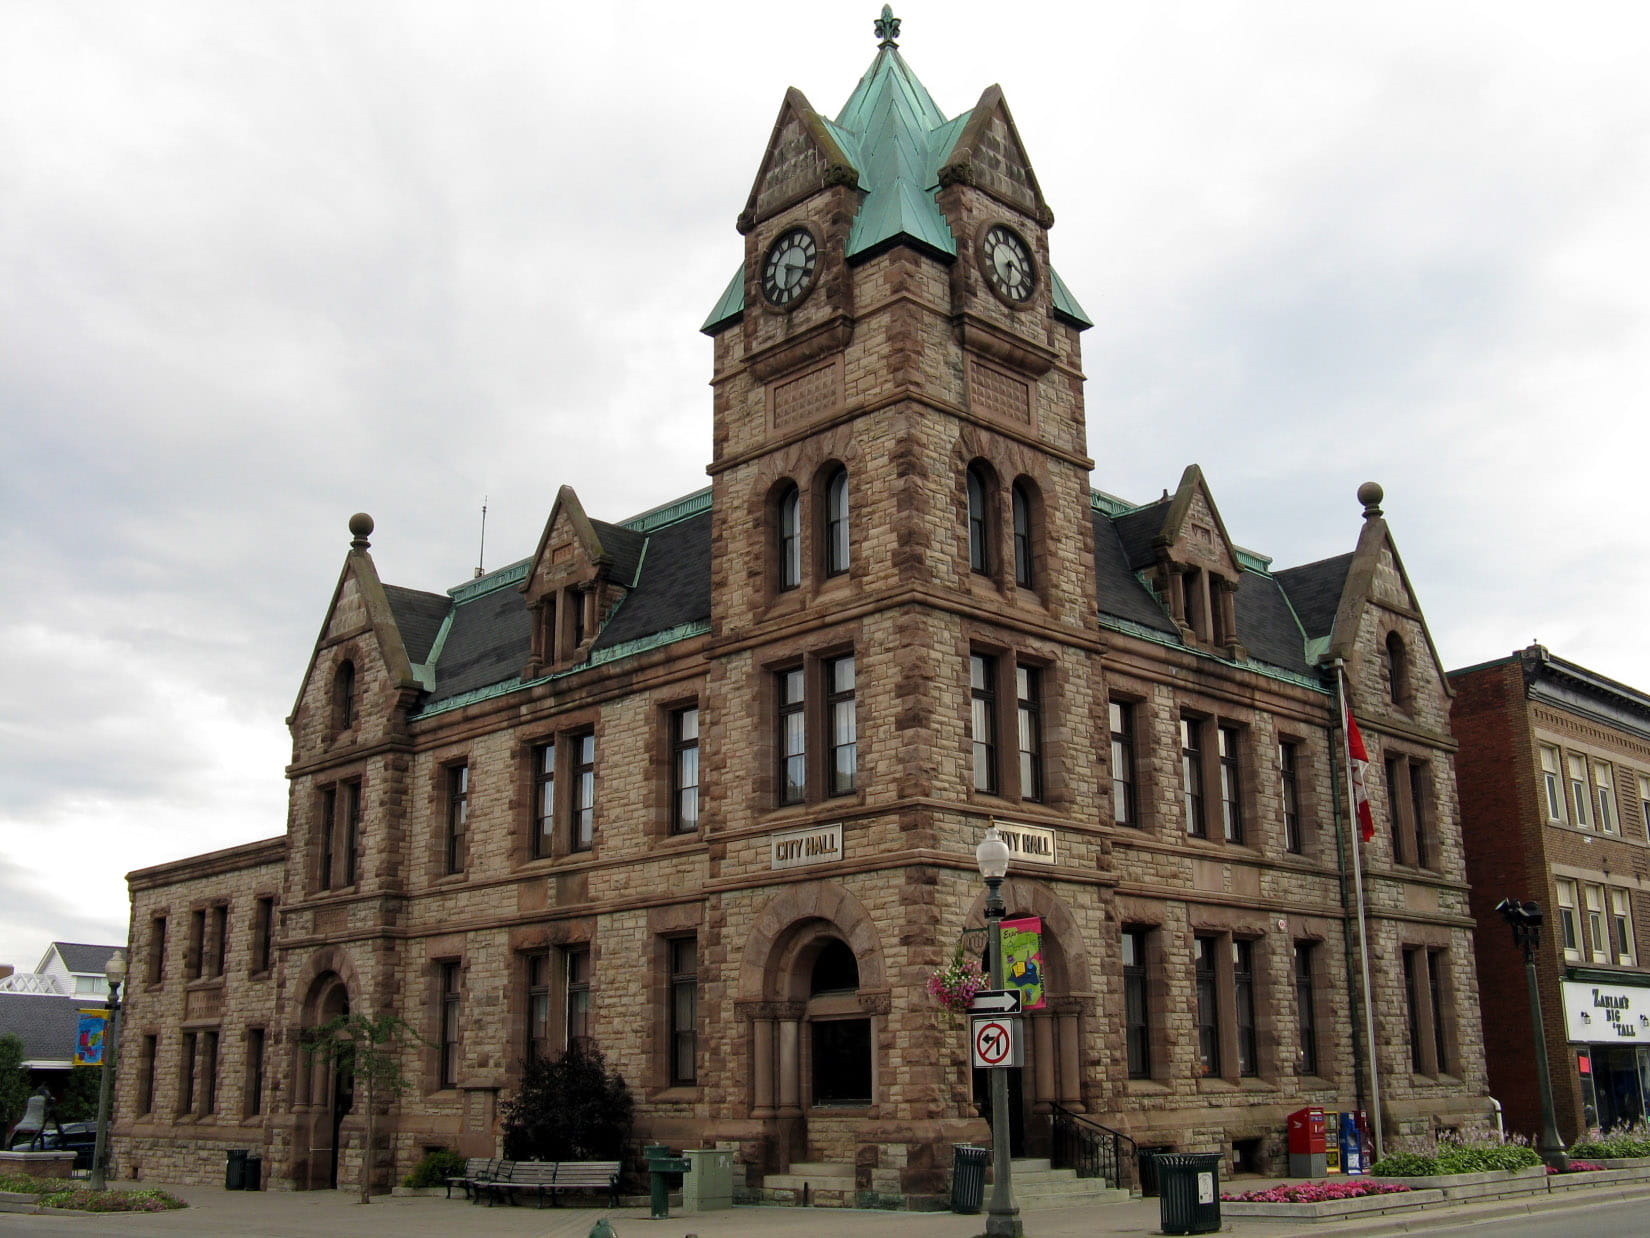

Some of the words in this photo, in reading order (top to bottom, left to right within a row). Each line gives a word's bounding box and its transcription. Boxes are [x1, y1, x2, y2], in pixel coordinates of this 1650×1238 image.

[776, 838, 804, 860] CITY
[804, 833, 838, 856] HALL
[999, 830, 1021, 852] ITY
[1022, 833, 1052, 856] HALL
[1606, 1009, 1621, 1022] BIG
